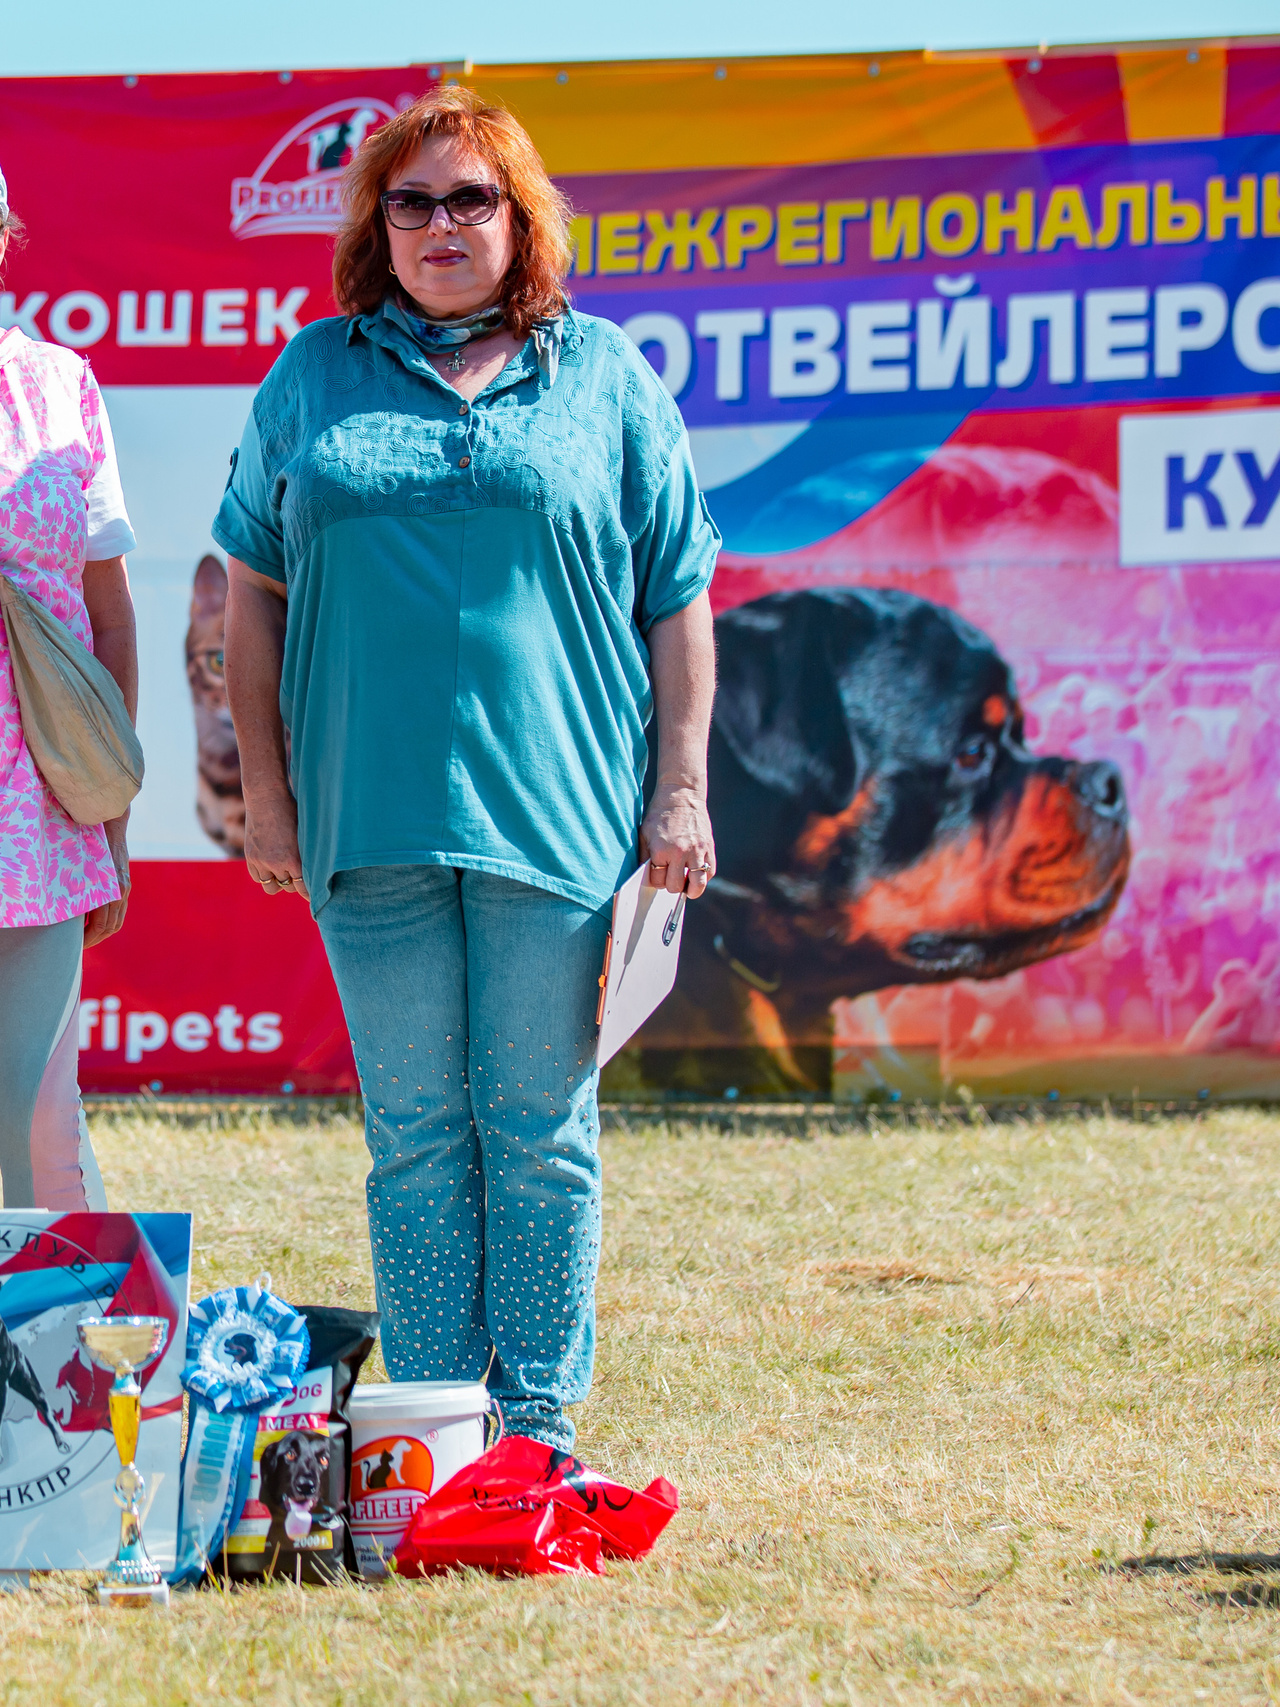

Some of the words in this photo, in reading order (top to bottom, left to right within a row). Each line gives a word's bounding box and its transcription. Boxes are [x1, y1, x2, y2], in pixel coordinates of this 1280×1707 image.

[570, 172, 1280, 276] ЕЖРЕГИОНАЛЬН
[618, 274, 1280, 401] ОТВЕЙЛЕРО
[1166, 447, 1280, 533] КУ
[265, 1414, 321, 1430] MEAT
